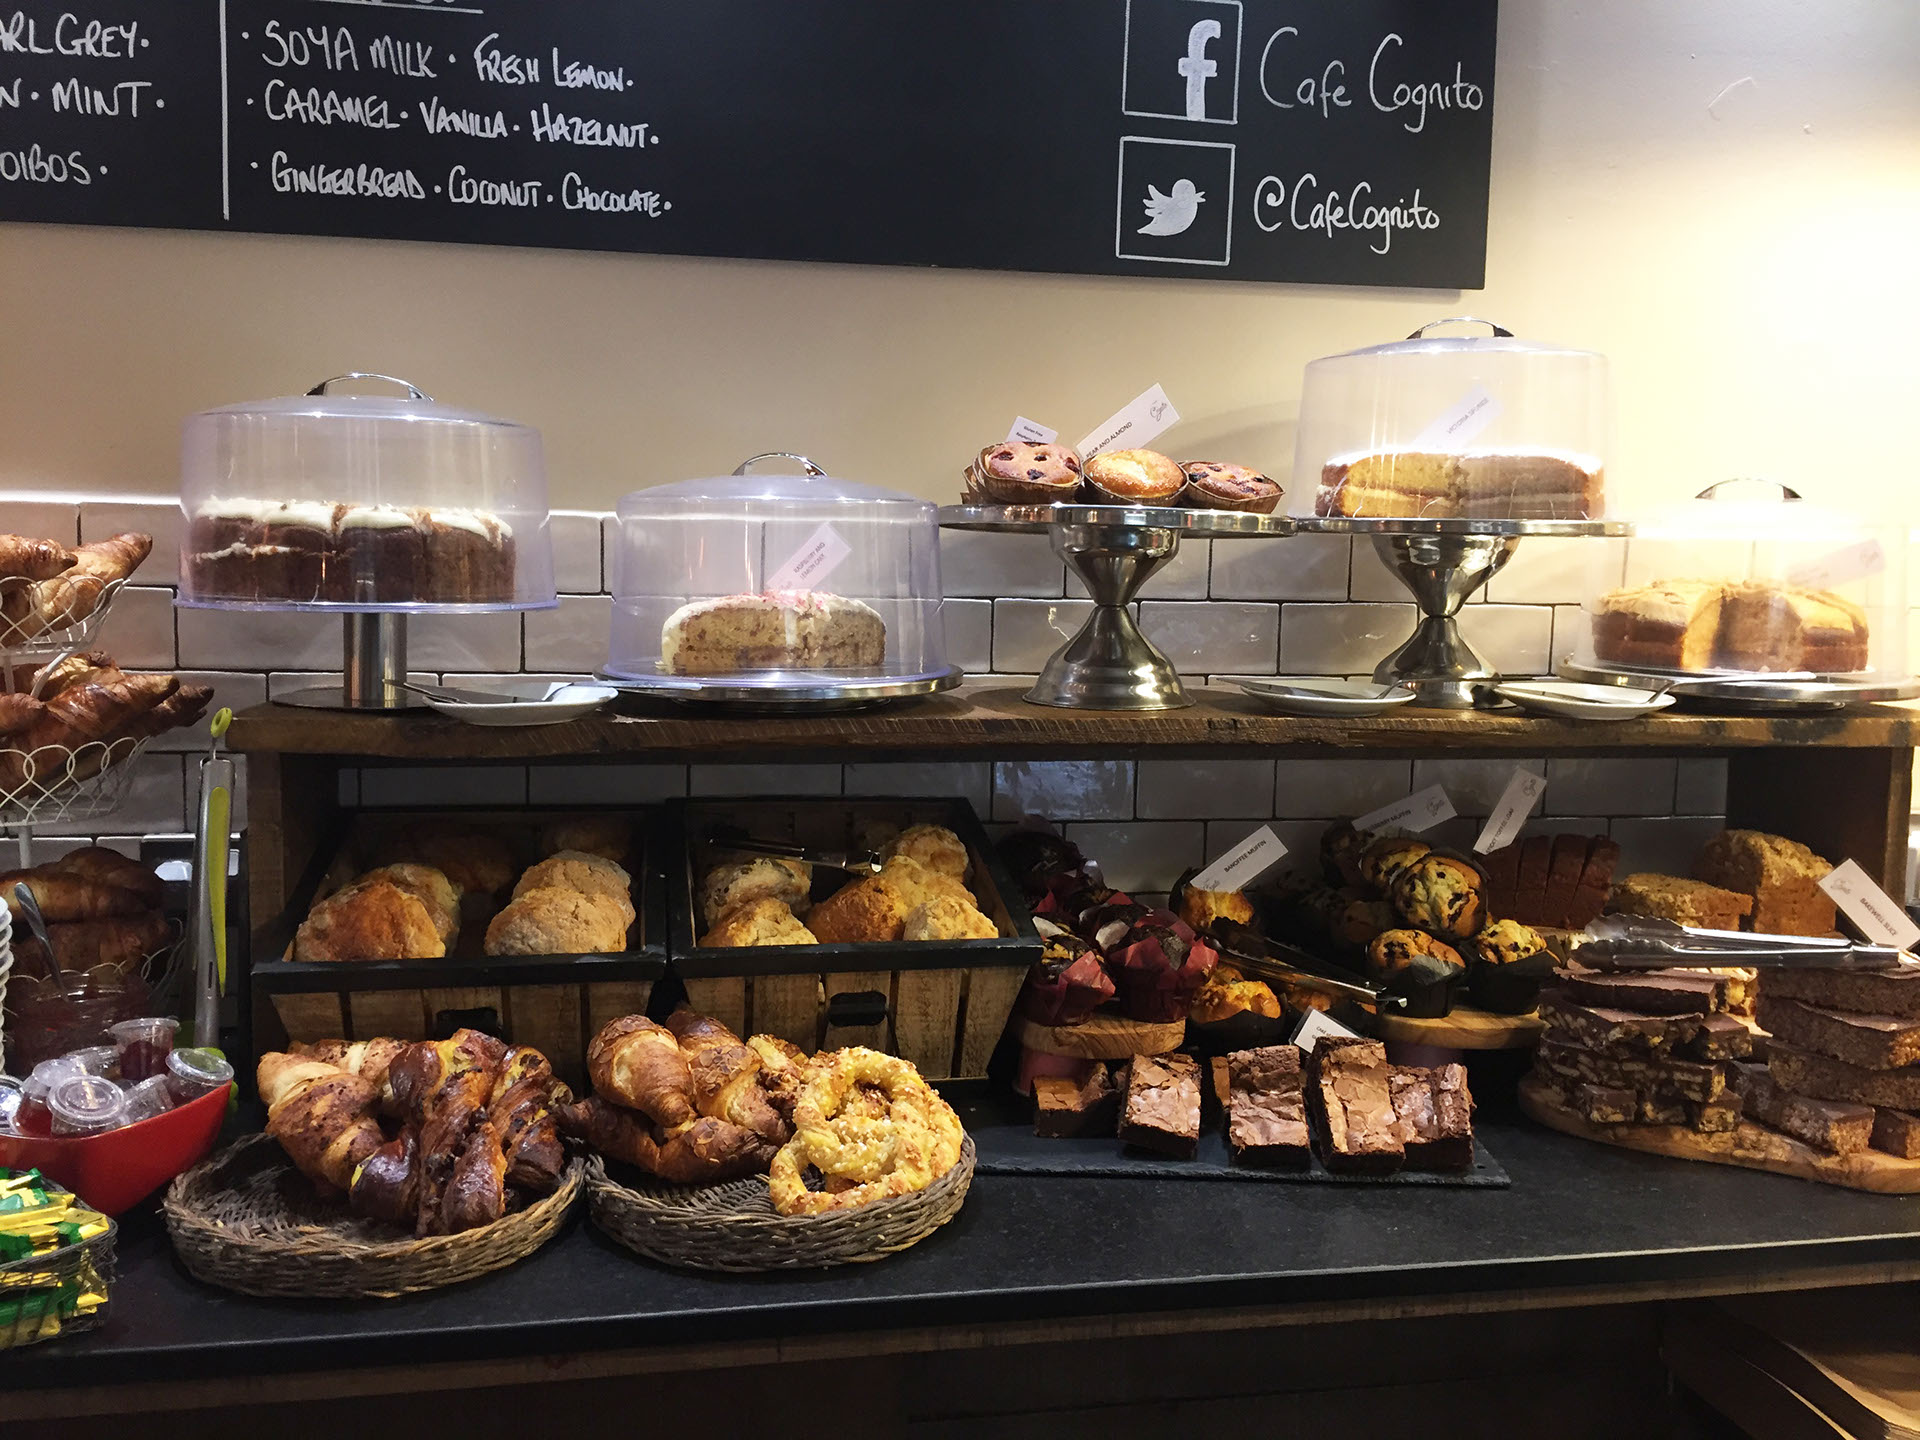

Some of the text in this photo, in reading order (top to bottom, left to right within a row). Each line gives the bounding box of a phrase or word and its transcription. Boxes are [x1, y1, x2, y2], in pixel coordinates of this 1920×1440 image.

[261, 19, 358, 71] SOYA
[370, 34, 438, 79] MILK
[474, 32, 540, 86] FRESH
[1259, 26, 1484, 133] Cafe Cognito
[52, 77, 152, 117] MINT
[264, 78, 649, 149] CARAMEL VANILLA HAZELNUT
[271, 150, 662, 217] GINGERBREAD COCONUT CHOCOLATE
[1253, 172, 1440, 255] @CafeCognito
[1099, 437, 1111, 449] AND
[1110, 421, 1132, 441] ALMOND
[1247, 839, 1267, 856] MUFFIN
